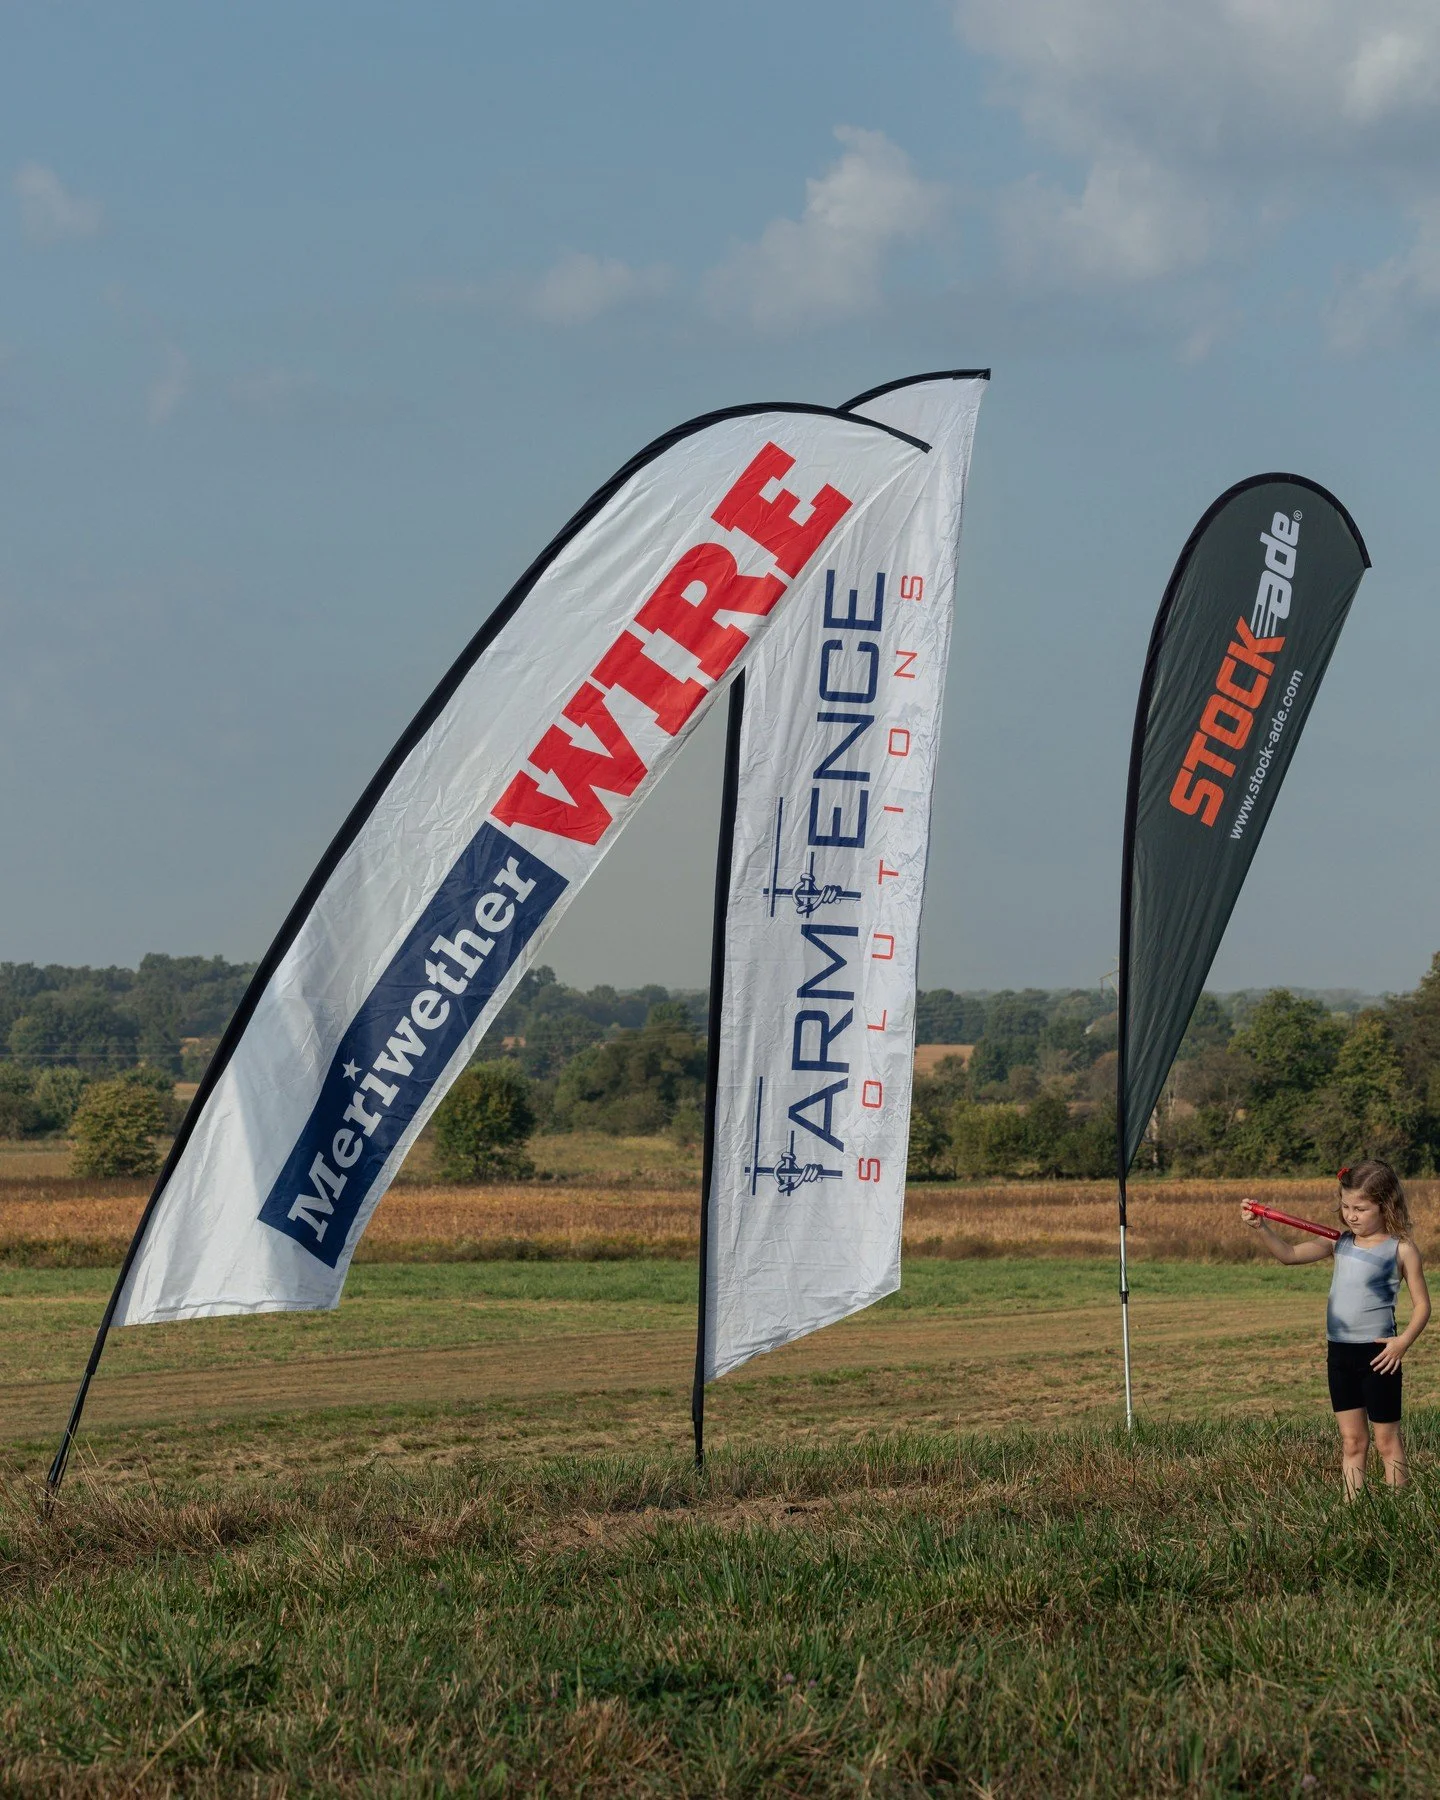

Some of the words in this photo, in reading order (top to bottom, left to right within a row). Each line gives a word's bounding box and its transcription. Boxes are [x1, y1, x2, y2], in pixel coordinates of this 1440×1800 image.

[286, 855, 537, 1244] Meriwether
[491, 442, 852, 846] WIRE
[858, 575, 924, 1183] SOLUTIONS
[1230, 669, 1304, 840] www.stock-ade.com
